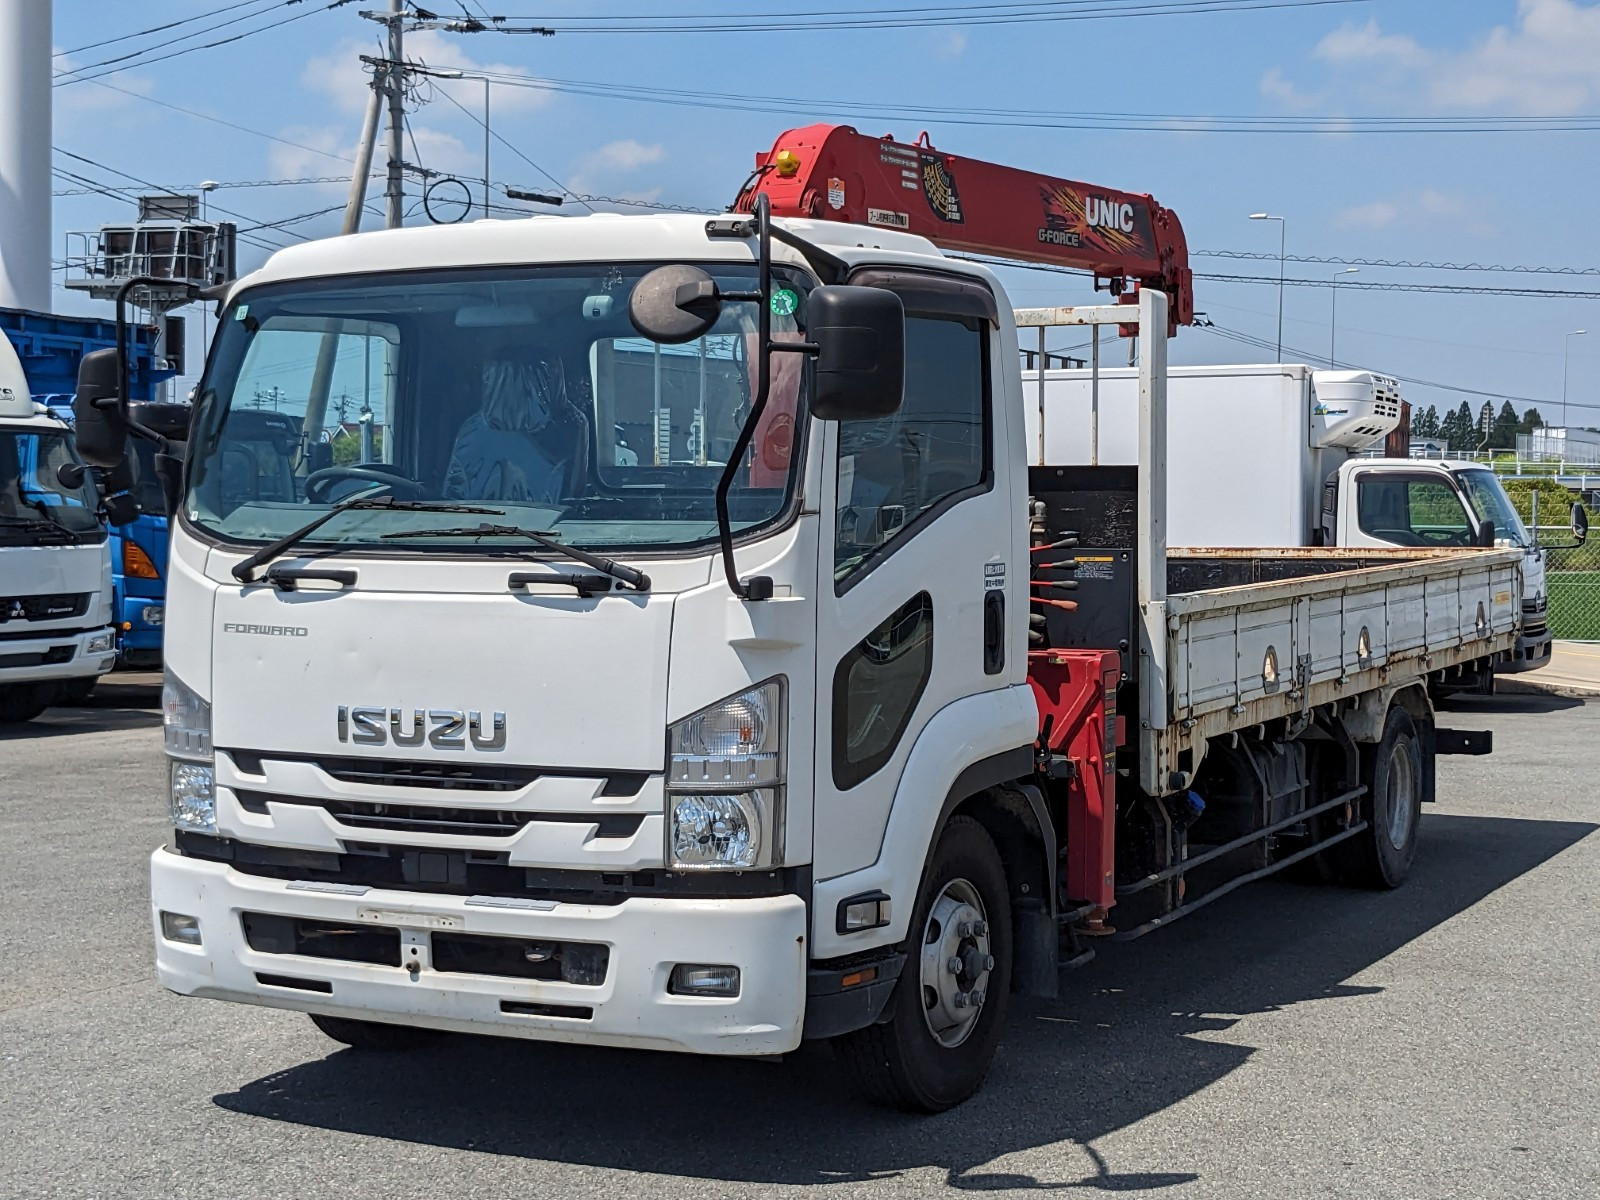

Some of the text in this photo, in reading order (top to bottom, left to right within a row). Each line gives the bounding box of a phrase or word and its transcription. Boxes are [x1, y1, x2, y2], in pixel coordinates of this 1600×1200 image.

[1085, 196, 1134, 233] UNIC
[1038, 228, 1079, 247] G-FORCE
[223, 623, 308, 637] FORWARD
[338, 704, 507, 752] ISUZU
